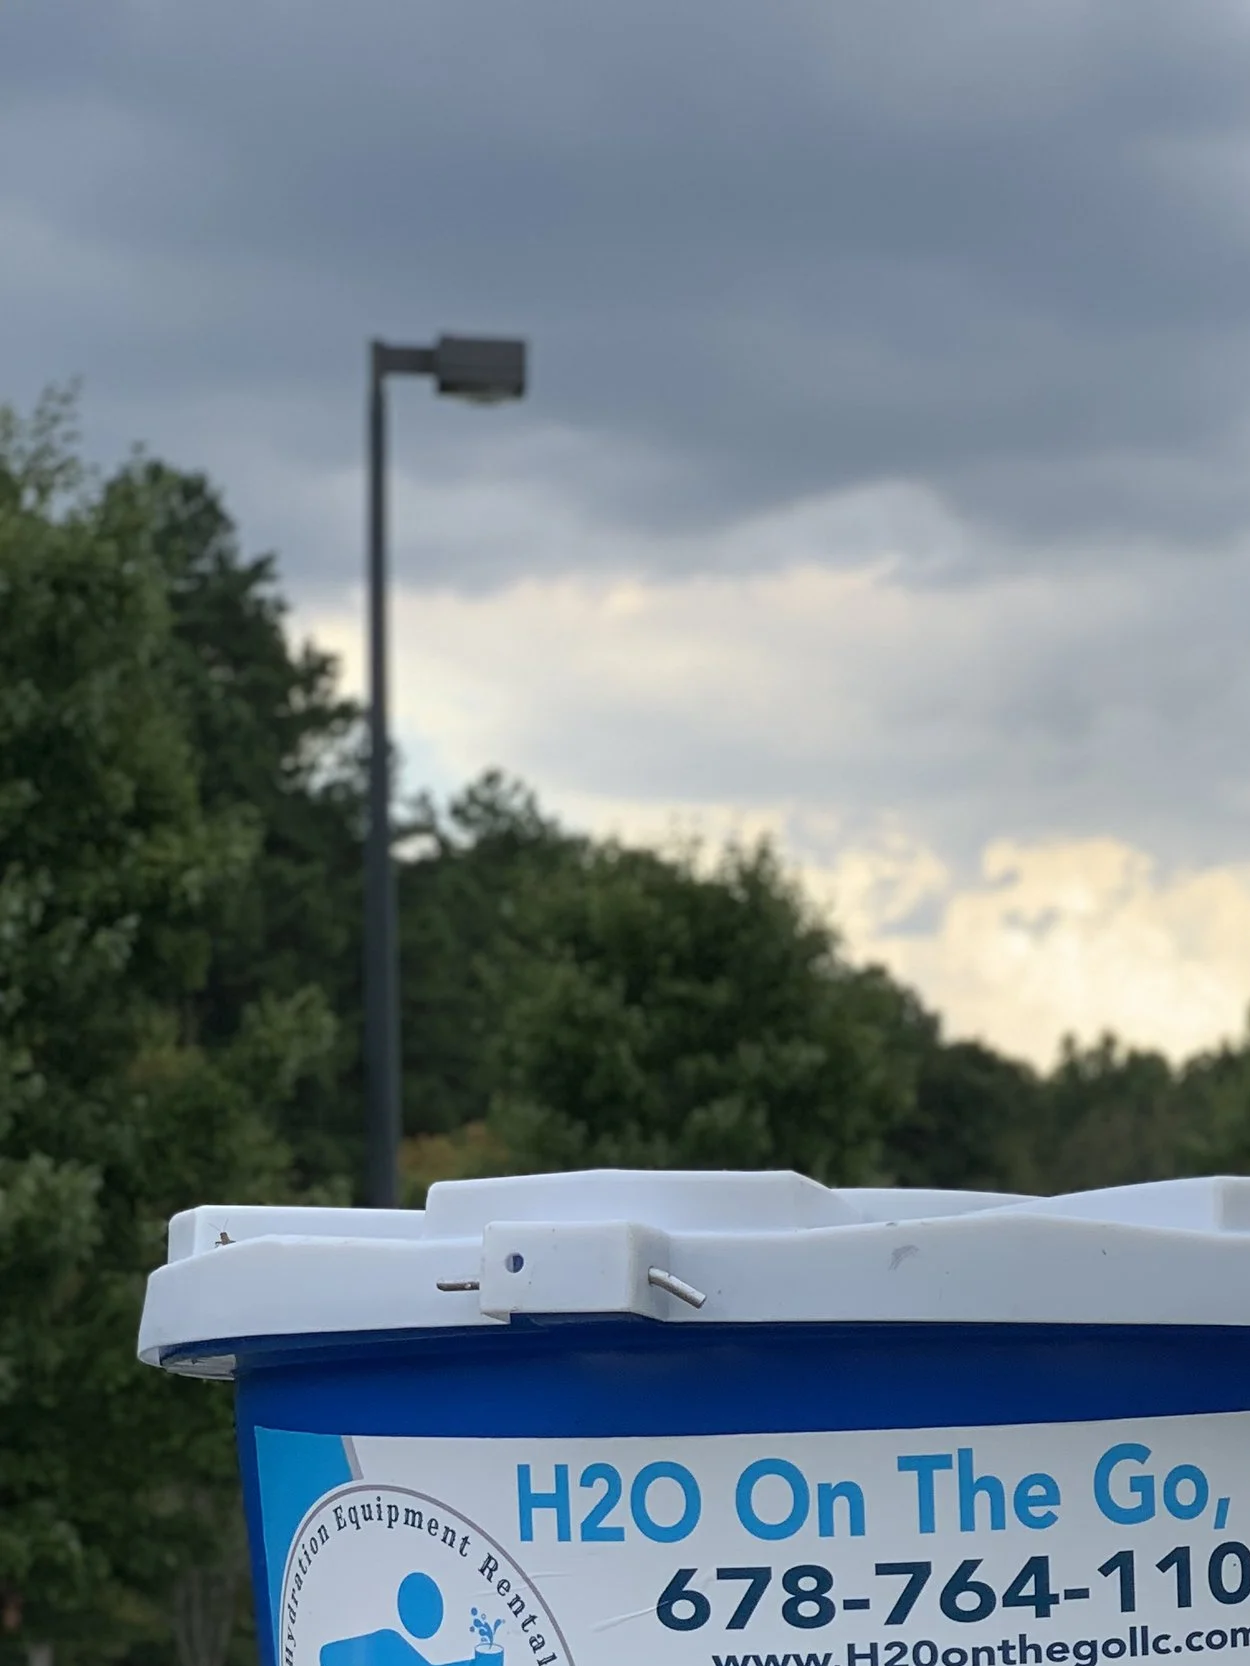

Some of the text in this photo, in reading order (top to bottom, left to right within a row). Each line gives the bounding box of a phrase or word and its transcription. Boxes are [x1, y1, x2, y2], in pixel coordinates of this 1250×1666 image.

[333, 1497, 472, 1558] Equipment
[516, 1459, 702, 1545] H2O
[735, 1458, 867, 1541] On
[898, 1448, 1061, 1535] The
[1093, 1442, 1232, 1531] Go,
